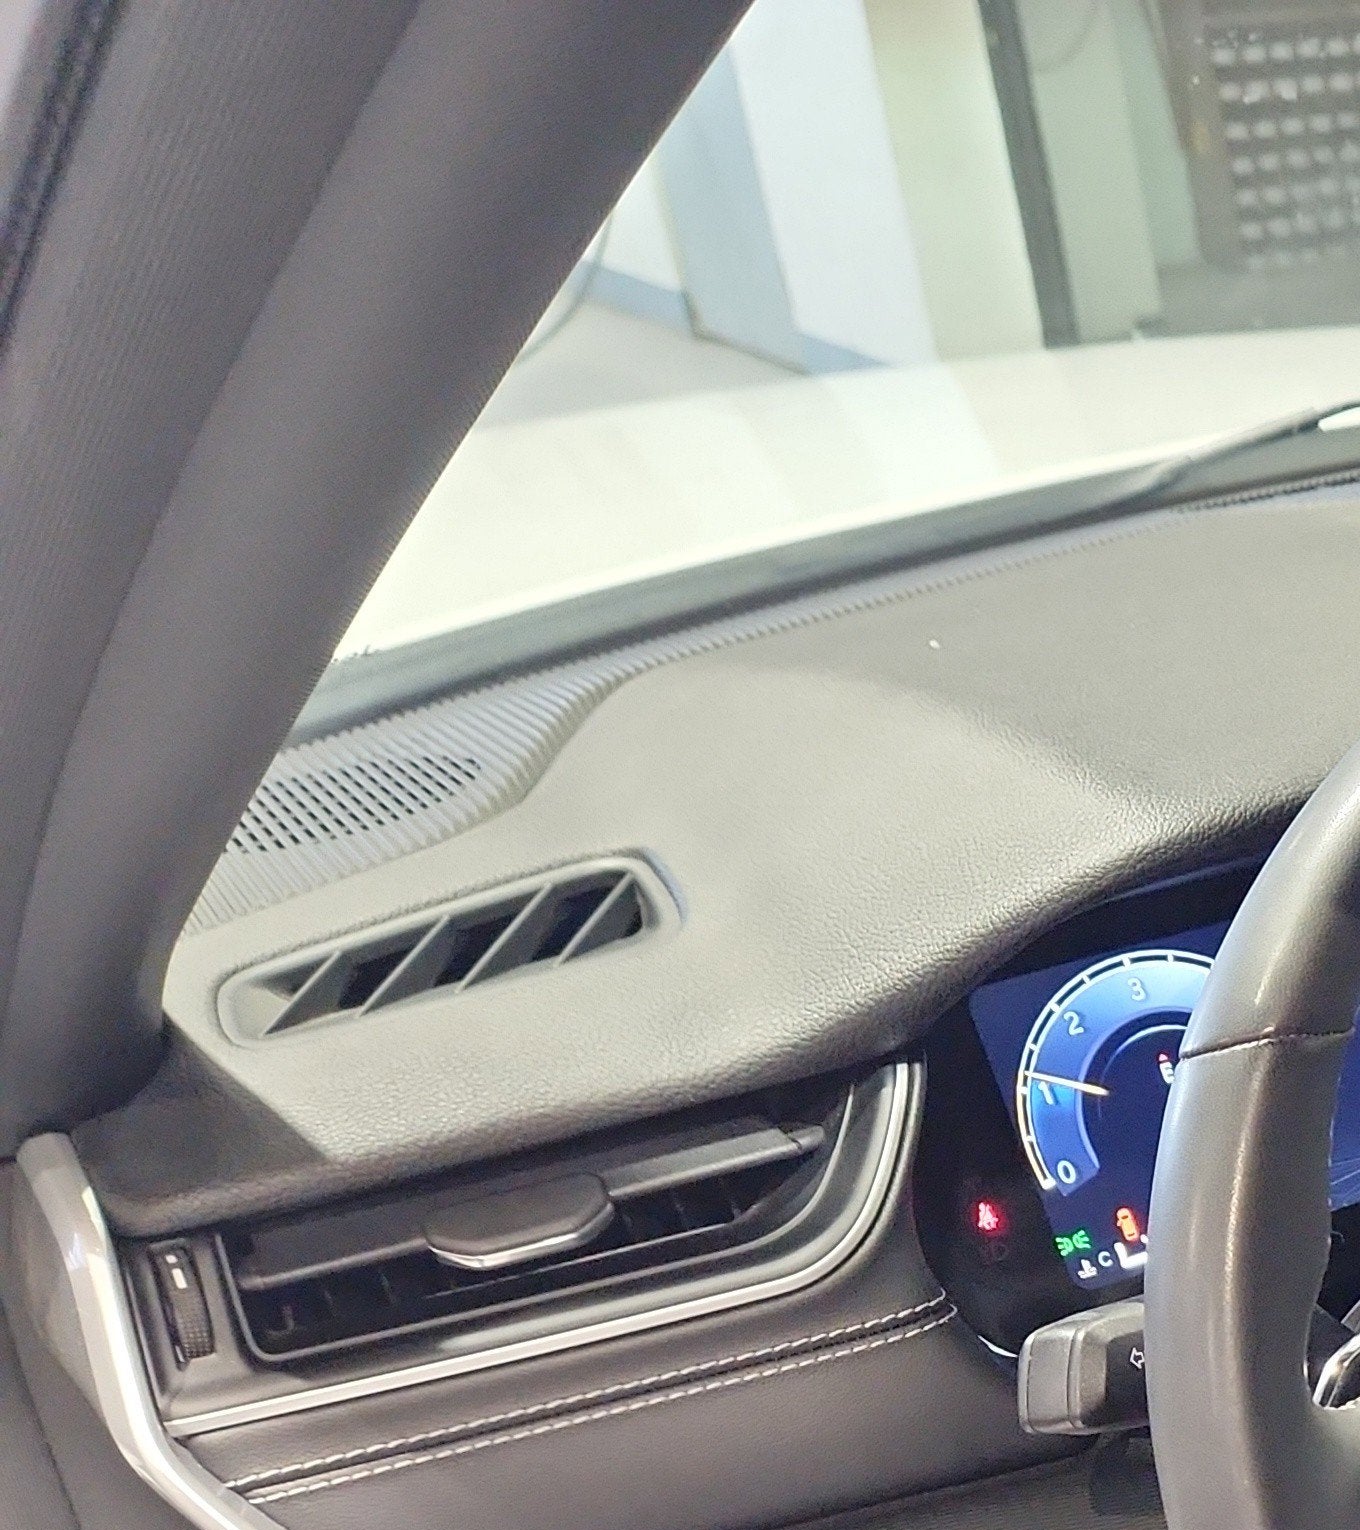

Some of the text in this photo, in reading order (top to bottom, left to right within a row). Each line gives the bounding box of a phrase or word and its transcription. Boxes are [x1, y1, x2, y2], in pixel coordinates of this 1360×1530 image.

[1127, 977, 1147, 1001] 3
[1063, 1011, 1084, 1036] 2
[1038, 1081, 1055, 1105] 1
[1056, 1160, 1077, 1184] 0
[1097, 1250, 1114, 1268] C
